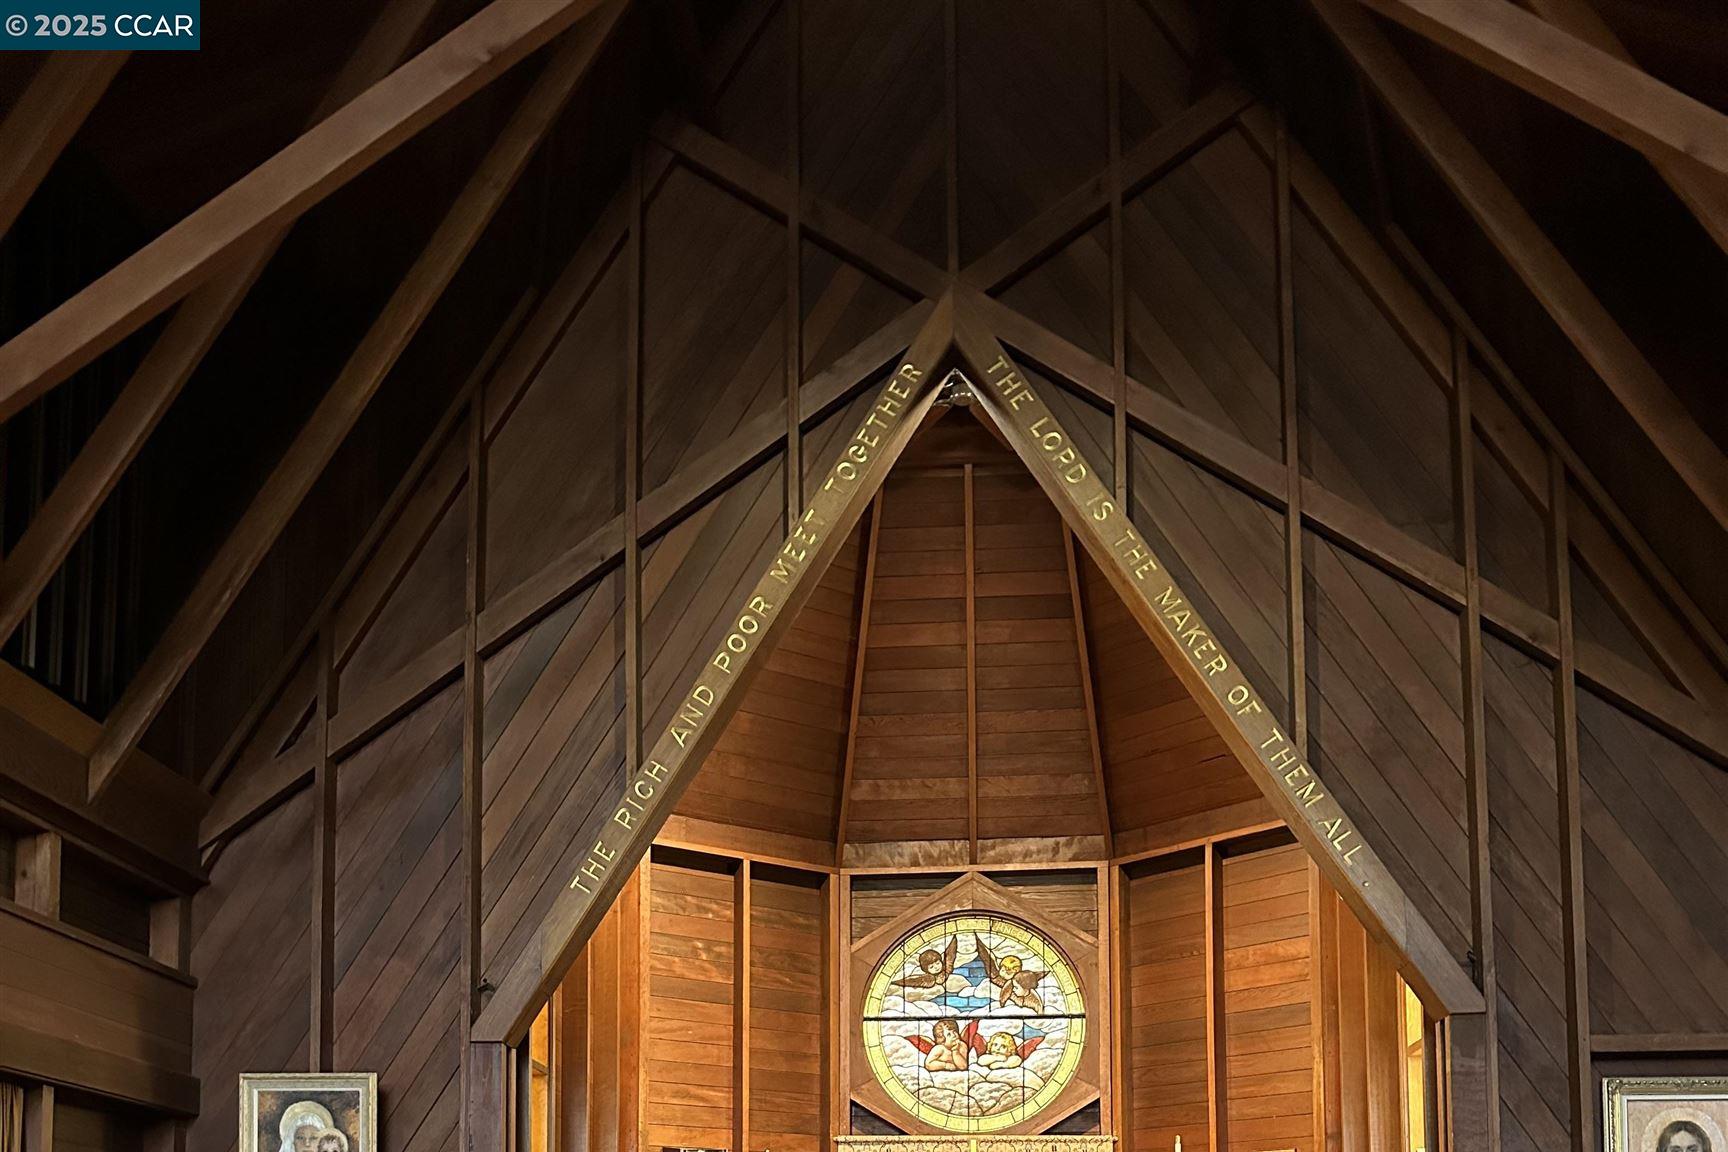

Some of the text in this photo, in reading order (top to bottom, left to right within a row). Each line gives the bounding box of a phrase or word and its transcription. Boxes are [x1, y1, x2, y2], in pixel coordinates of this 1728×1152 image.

[570, 363, 922, 894] THE RICH AND POOR MEET TOGETHER
[986, 356, 1034, 411] THE
[1029, 416, 1087, 484] LORD
[1086, 494, 1114, 521] IS
[1115, 529, 1157, 580] THE
[1154, 586, 1228, 677] MAKER
[1227, 685, 1262, 716] OF
[1260, 727, 1324, 809] THEM
